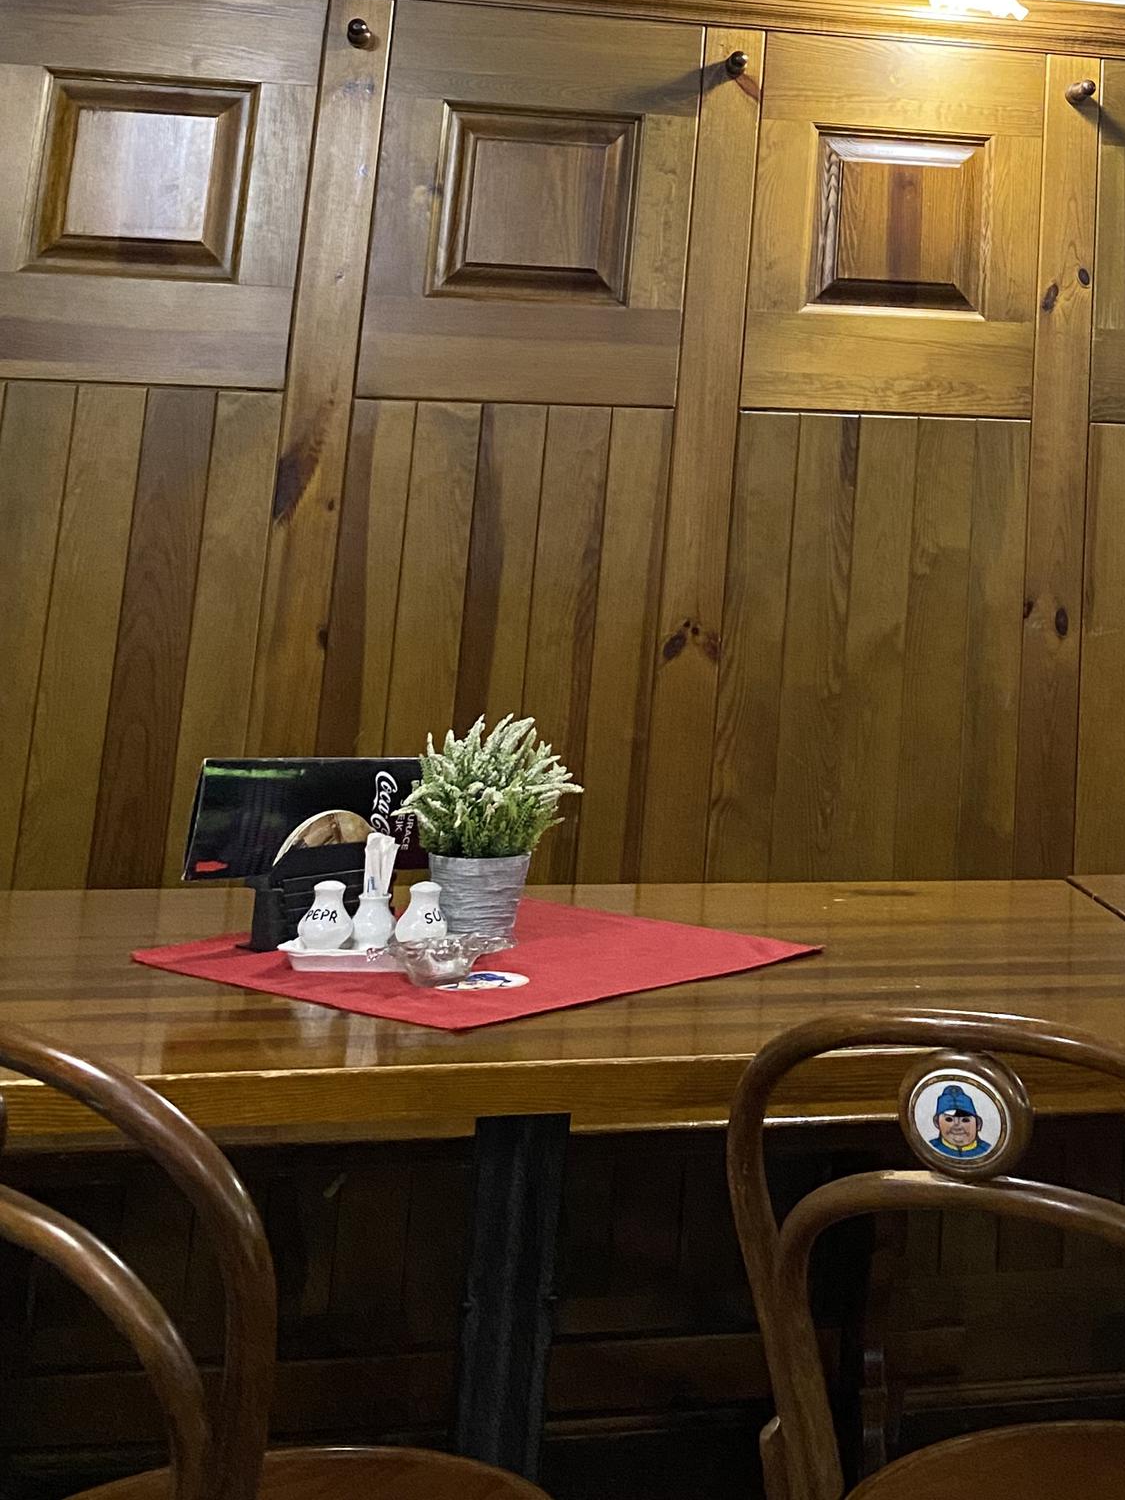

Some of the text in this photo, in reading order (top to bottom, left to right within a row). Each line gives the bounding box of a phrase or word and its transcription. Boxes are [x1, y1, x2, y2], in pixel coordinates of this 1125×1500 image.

[370, 770, 398, 837] Coca-C
[305, 908, 338, 924] PEPR
[424, 907, 446, 925] SÚ
